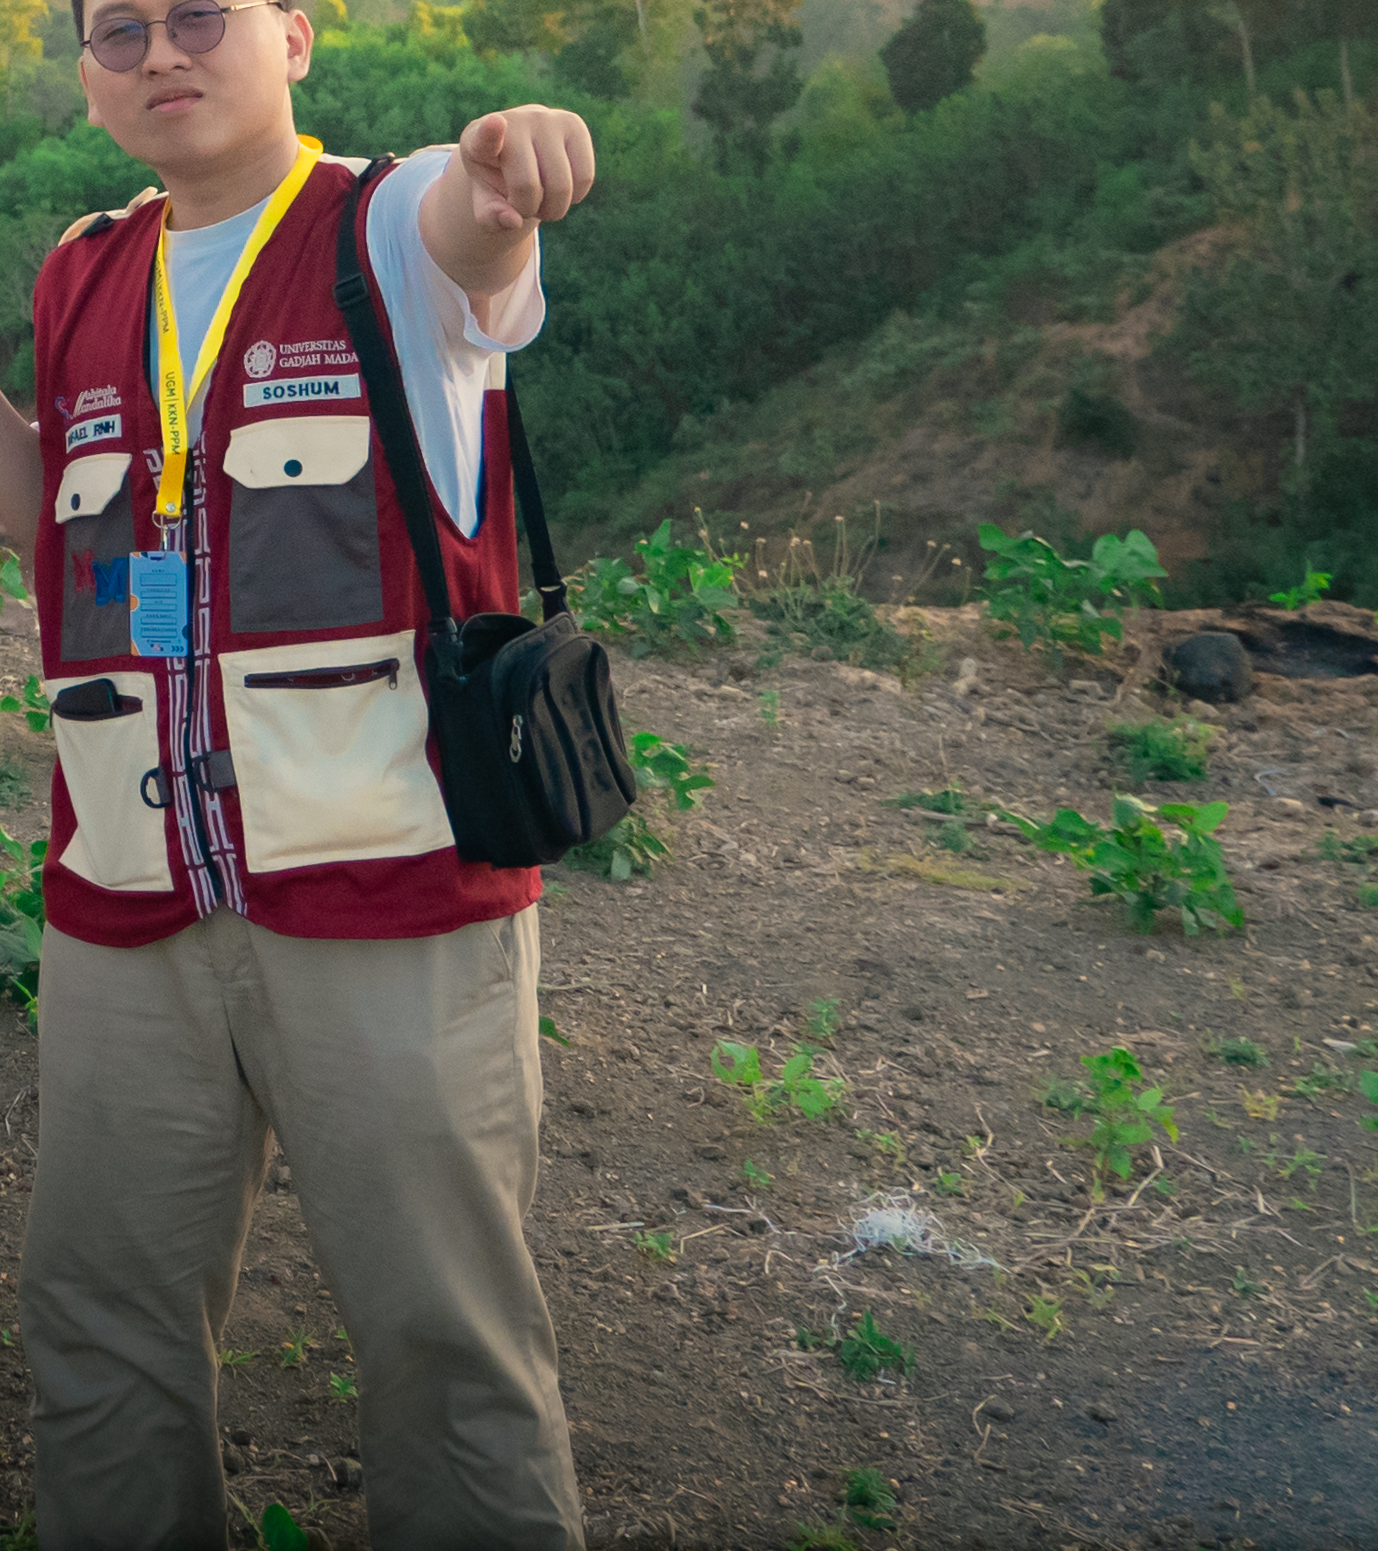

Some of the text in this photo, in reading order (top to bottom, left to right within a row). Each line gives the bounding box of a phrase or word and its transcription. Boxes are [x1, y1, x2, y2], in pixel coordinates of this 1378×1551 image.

[279, 340, 346, 355] UNIVERSITAS
[279, 352, 359, 368] GADJAH MADA
[262, 380, 340, 400] SOSHUM
